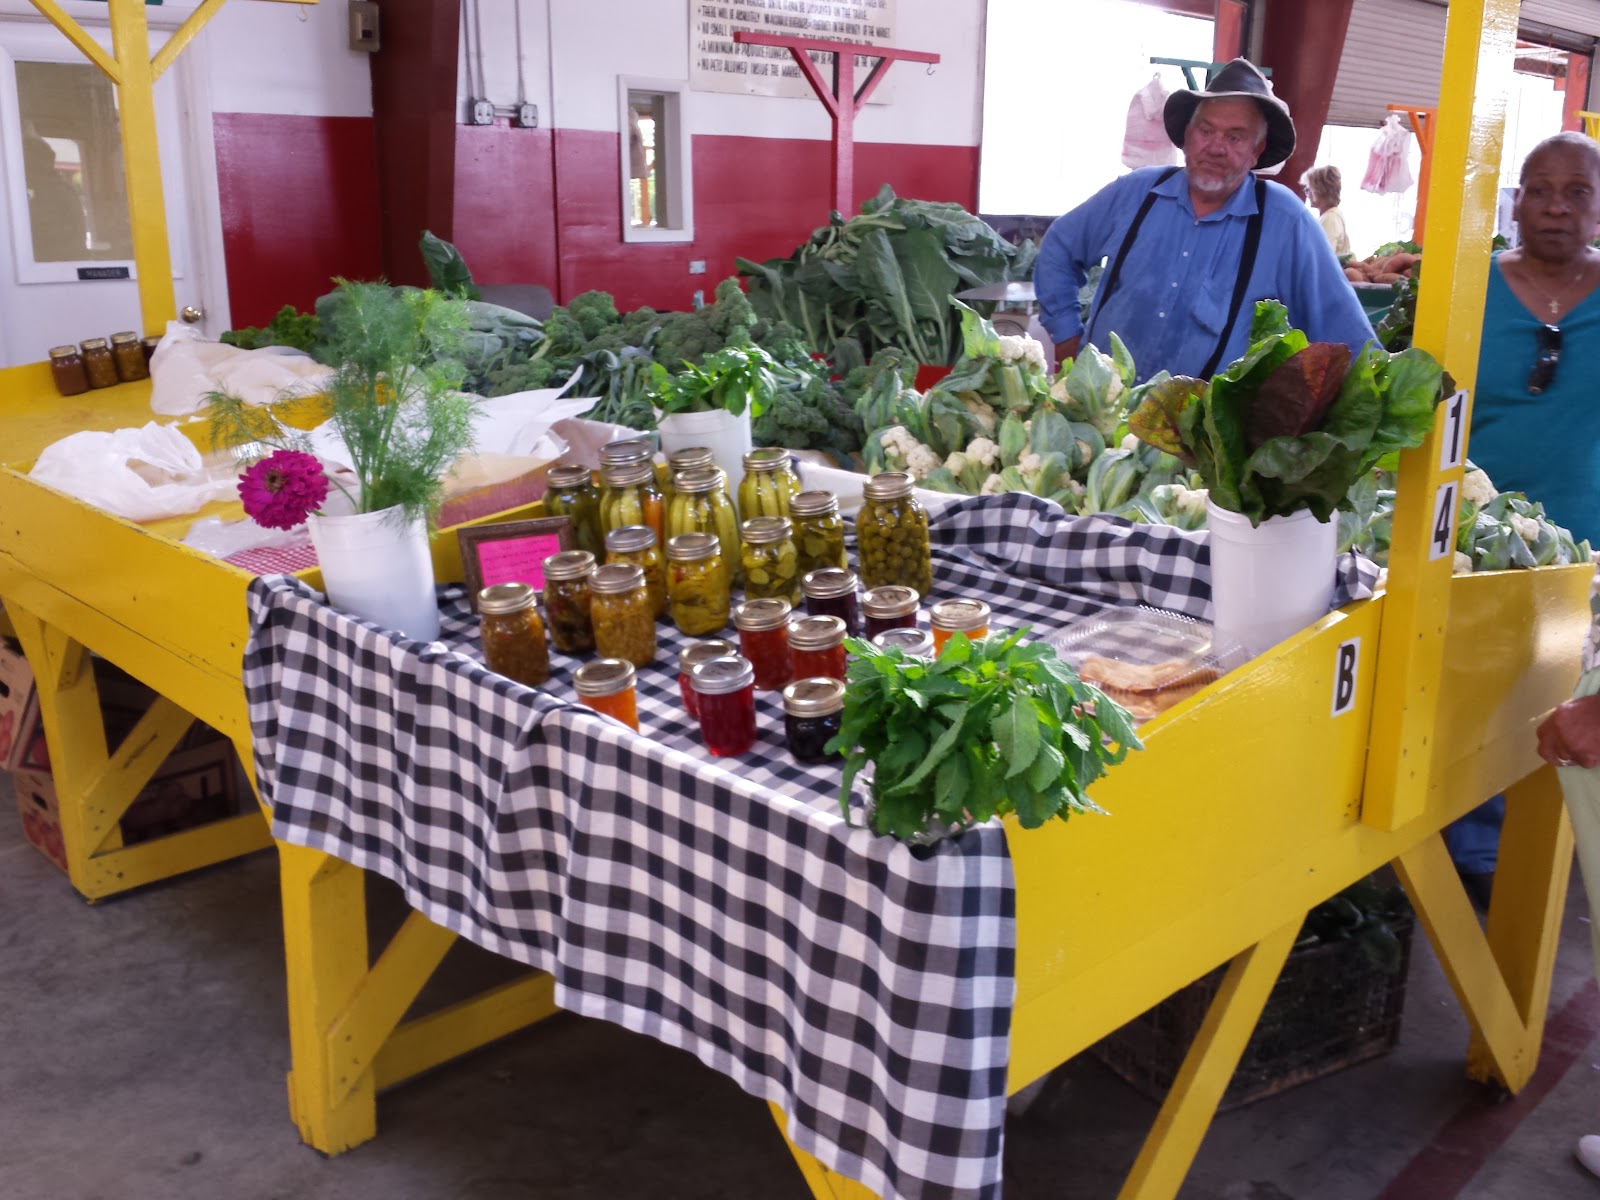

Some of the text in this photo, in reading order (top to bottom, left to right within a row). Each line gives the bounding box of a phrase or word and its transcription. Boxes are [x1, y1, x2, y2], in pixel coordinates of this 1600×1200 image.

[1449, 393, 1464, 464] 1
[1433, 486, 1453, 554] 4
[1335, 643, 1356, 712] B
